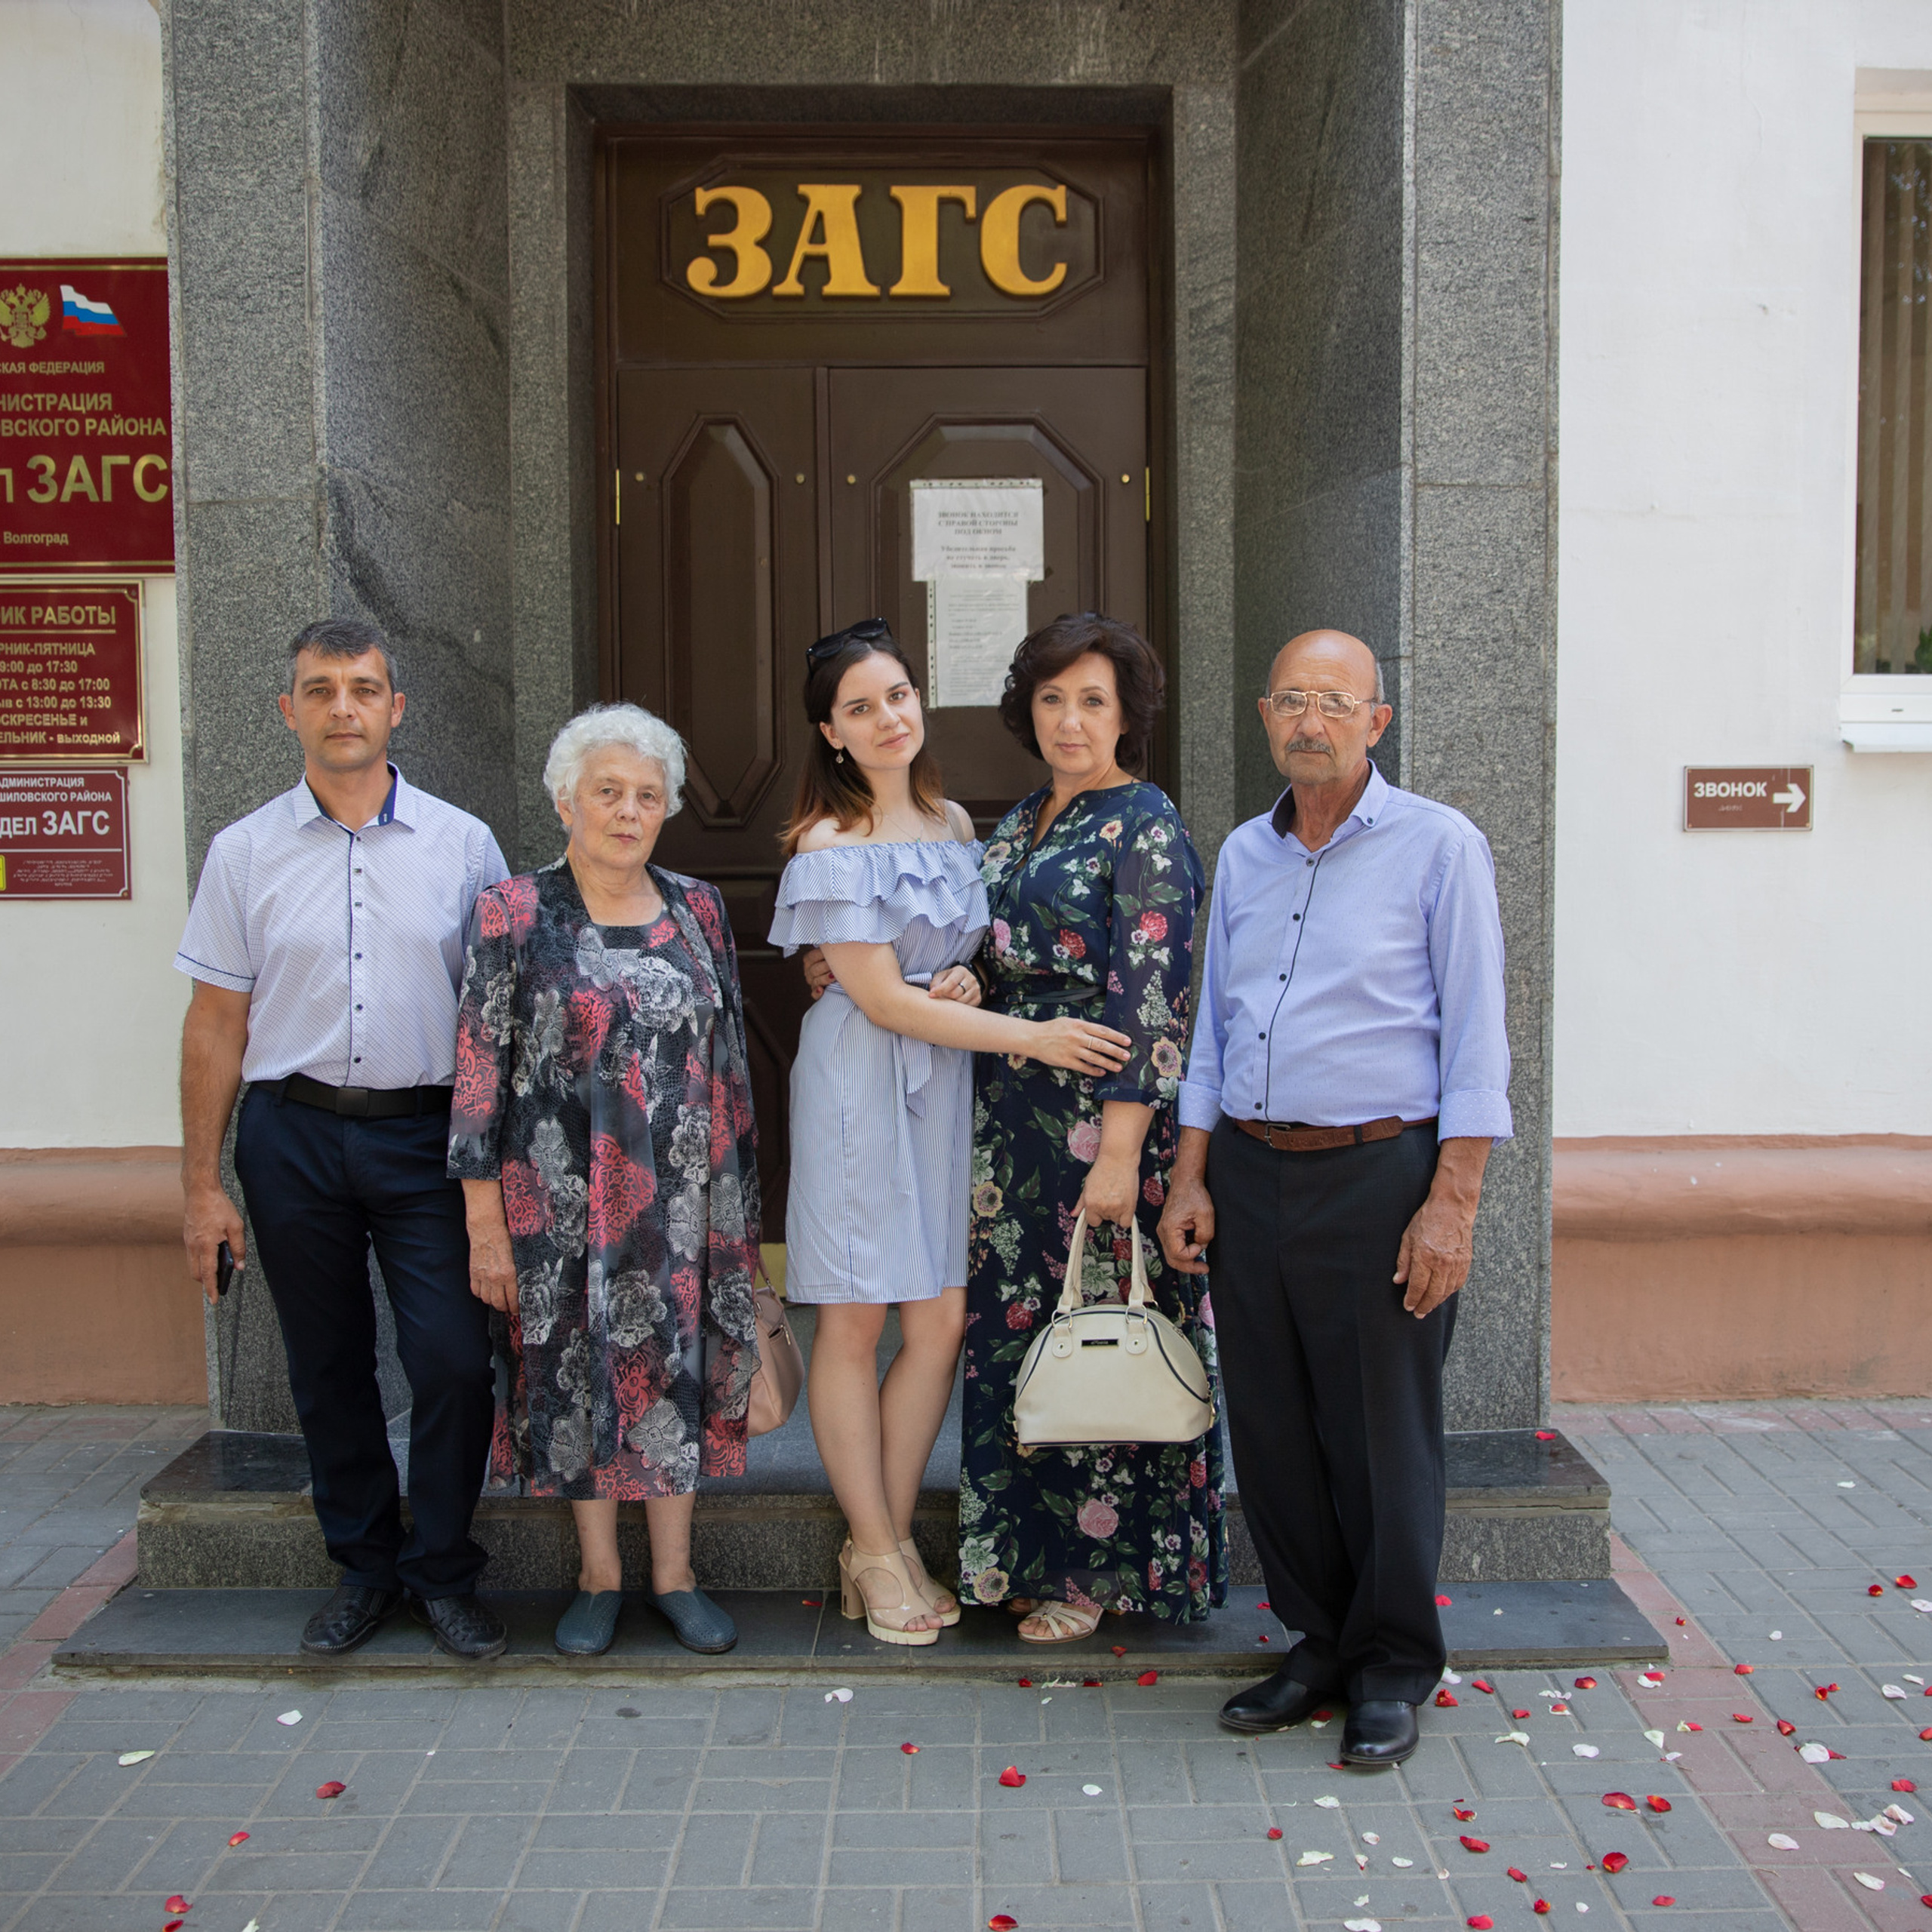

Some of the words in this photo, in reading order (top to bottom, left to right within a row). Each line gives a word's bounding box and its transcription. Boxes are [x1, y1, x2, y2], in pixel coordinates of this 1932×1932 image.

[686, 183, 1068, 298] ЗАГС
[0, 361, 26, 374] КАЯ
[29, 361, 104, 375] ФЕДЕРАЦИЯ
[85, 414, 167, 436] РАЙОНА
[26, 454, 168, 503] ЗАГС
[3, 531, 69, 546] Волгоград
[1, 606, 26, 625] ИК
[32, 606, 115, 625] РАБОТЫ
[26, 663, 43, 675] до
[46, 660, 78, 672] 17:30
[0, 678, 18, 690] ТА
[21, 681, 29, 691] с
[32, 678, 56, 691] 8:30
[59, 681, 75, 692] до
[78, 678, 110, 691] 17:00
[16, 698, 23, 709] с
[26, 696, 57, 708] 13:00
[60, 699, 76, 709] до
[80, 696, 112, 709] 13:30
[0, 714, 77, 726] СКРЕСЕНЬЕ
[57, 731, 120, 745] выходной
[0, 777, 85, 789] ДМИНИСТРАЦИЯ
[1694, 782, 1767, 798] ЗВОНОК
[70, 790, 112, 801] РАЙОНА
[42, 810, 109, 835] ЗАГС
